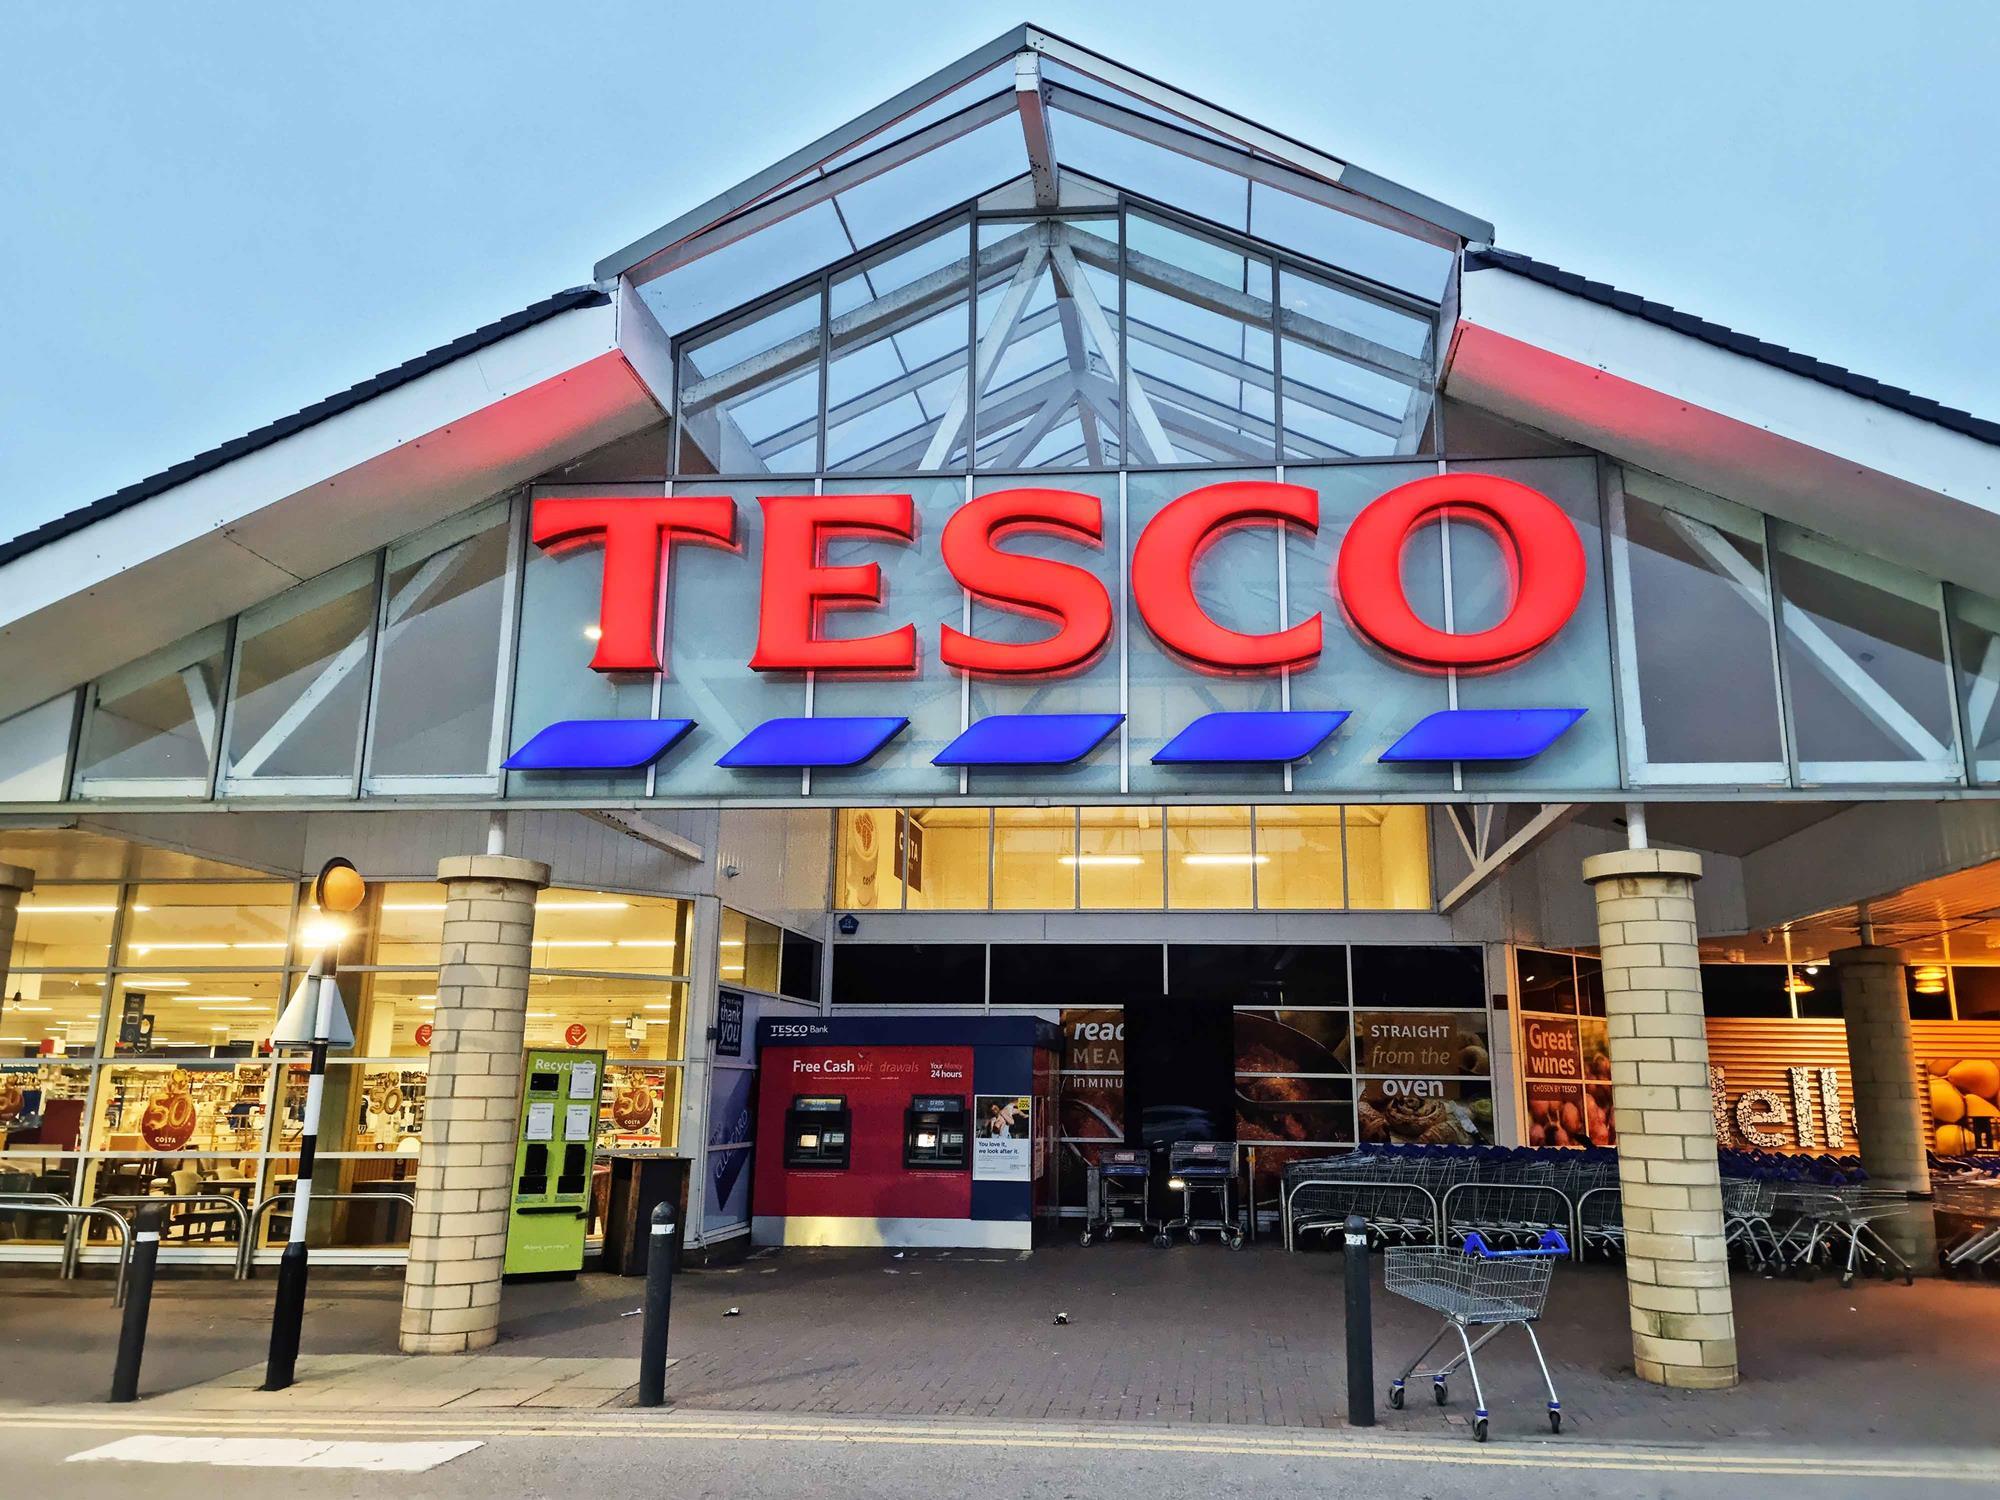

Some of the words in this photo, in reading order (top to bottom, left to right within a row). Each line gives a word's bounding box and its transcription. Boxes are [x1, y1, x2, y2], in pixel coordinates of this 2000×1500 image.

[531, 473, 1588, 675] TESCO
[720, 1003, 741, 1023] thank
[720, 1022, 740, 1045] you
[770, 1025, 808, 1034] TESCO
[809, 1024, 829, 1034] Bank
[1370, 1025, 1450, 1038] STRAIGHT
[1529, 1023, 1575, 1052] Great
[1372, 1044, 1415, 1068] from
[1421, 1046, 1451, 1065] the
[1531, 1050, 1576, 1076] wines
[535, 1058, 575, 1073] Recycl
[793, 1060, 821, 1073] Free
[823, 1060, 855, 1073] Cash
[930, 1062, 943, 1070] Your
[930, 1070, 941, 1078] 24
[941, 1070, 963, 1078] hours
[1073, 1075, 1086, 1088] in
[1382, 1079, 1444, 1097] oven
[1532, 1084, 1554, 1093] CHOSEN
[1561, 1085, 1578, 1093] TESCO
[145, 1093, 190, 1131] 50
[154, 1135, 176, 1144] COSTA
